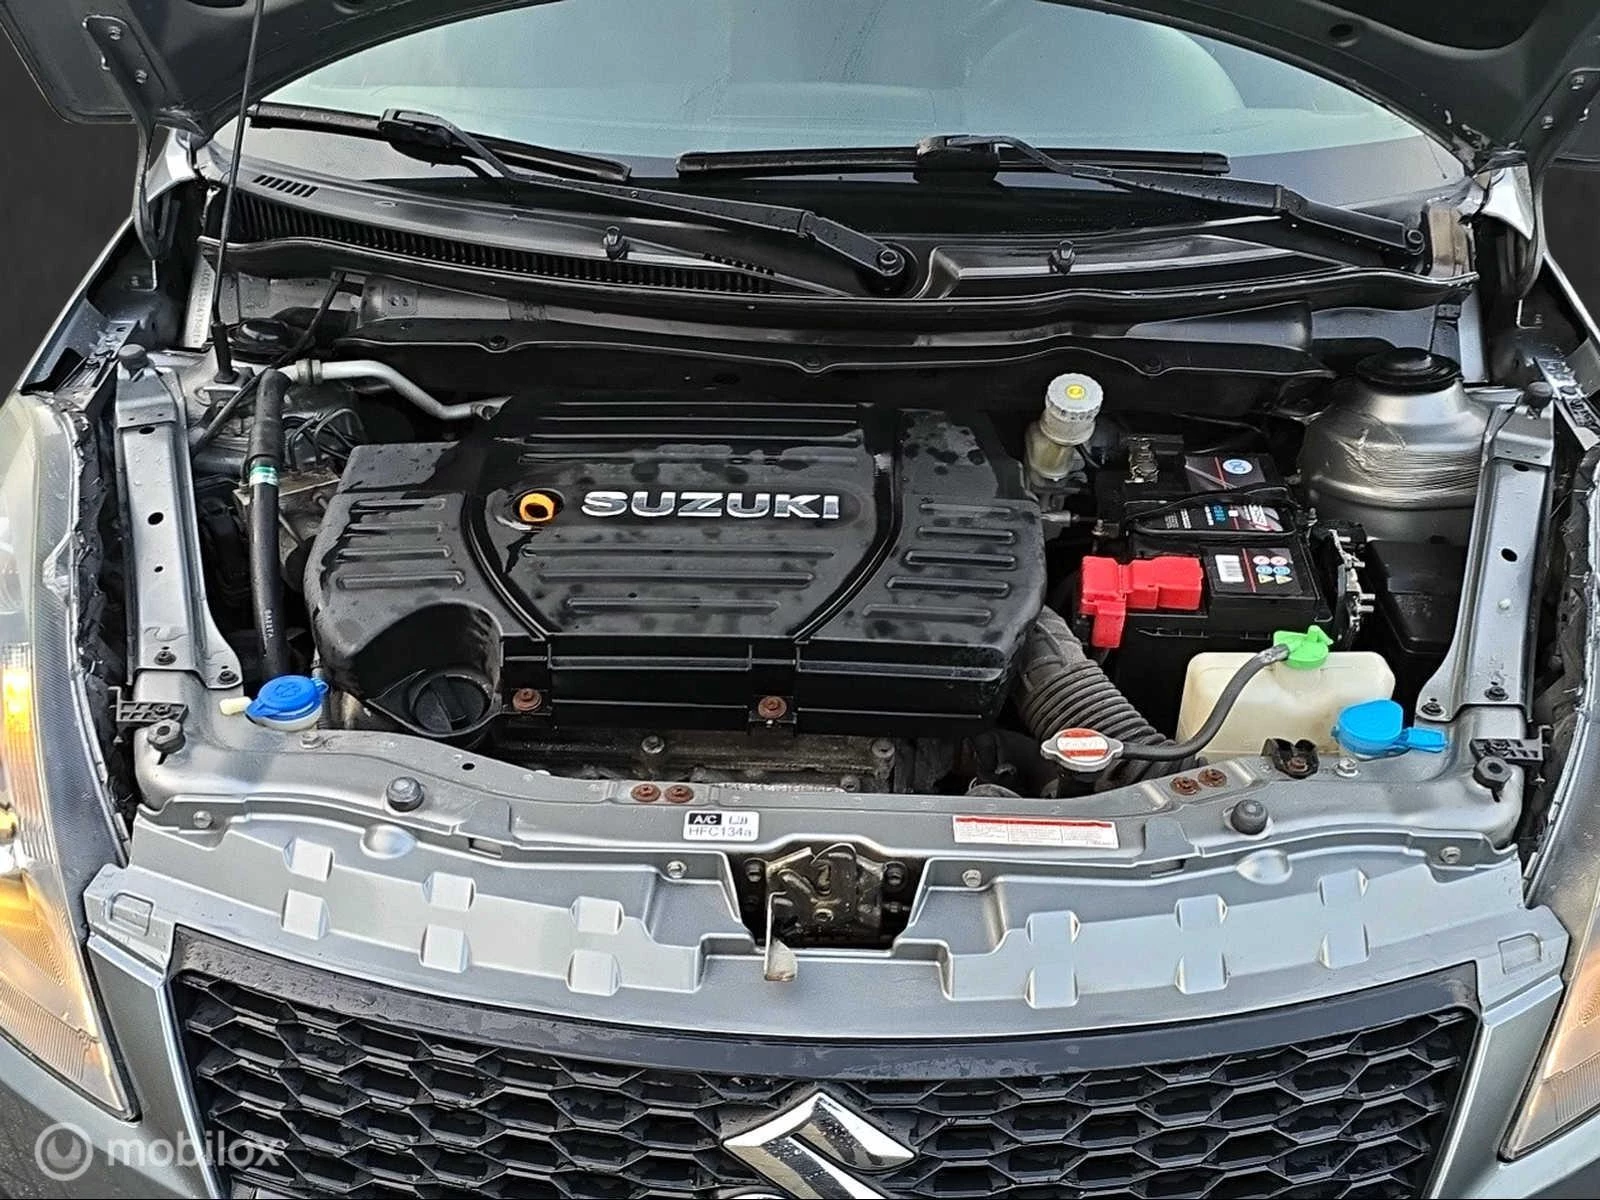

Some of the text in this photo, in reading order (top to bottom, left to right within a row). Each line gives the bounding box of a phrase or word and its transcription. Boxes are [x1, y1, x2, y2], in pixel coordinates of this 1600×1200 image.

[581, 491, 839, 519] SUZUKI
[692, 814, 718, 825] A/C
[688, 826, 752, 837] HFC134a
